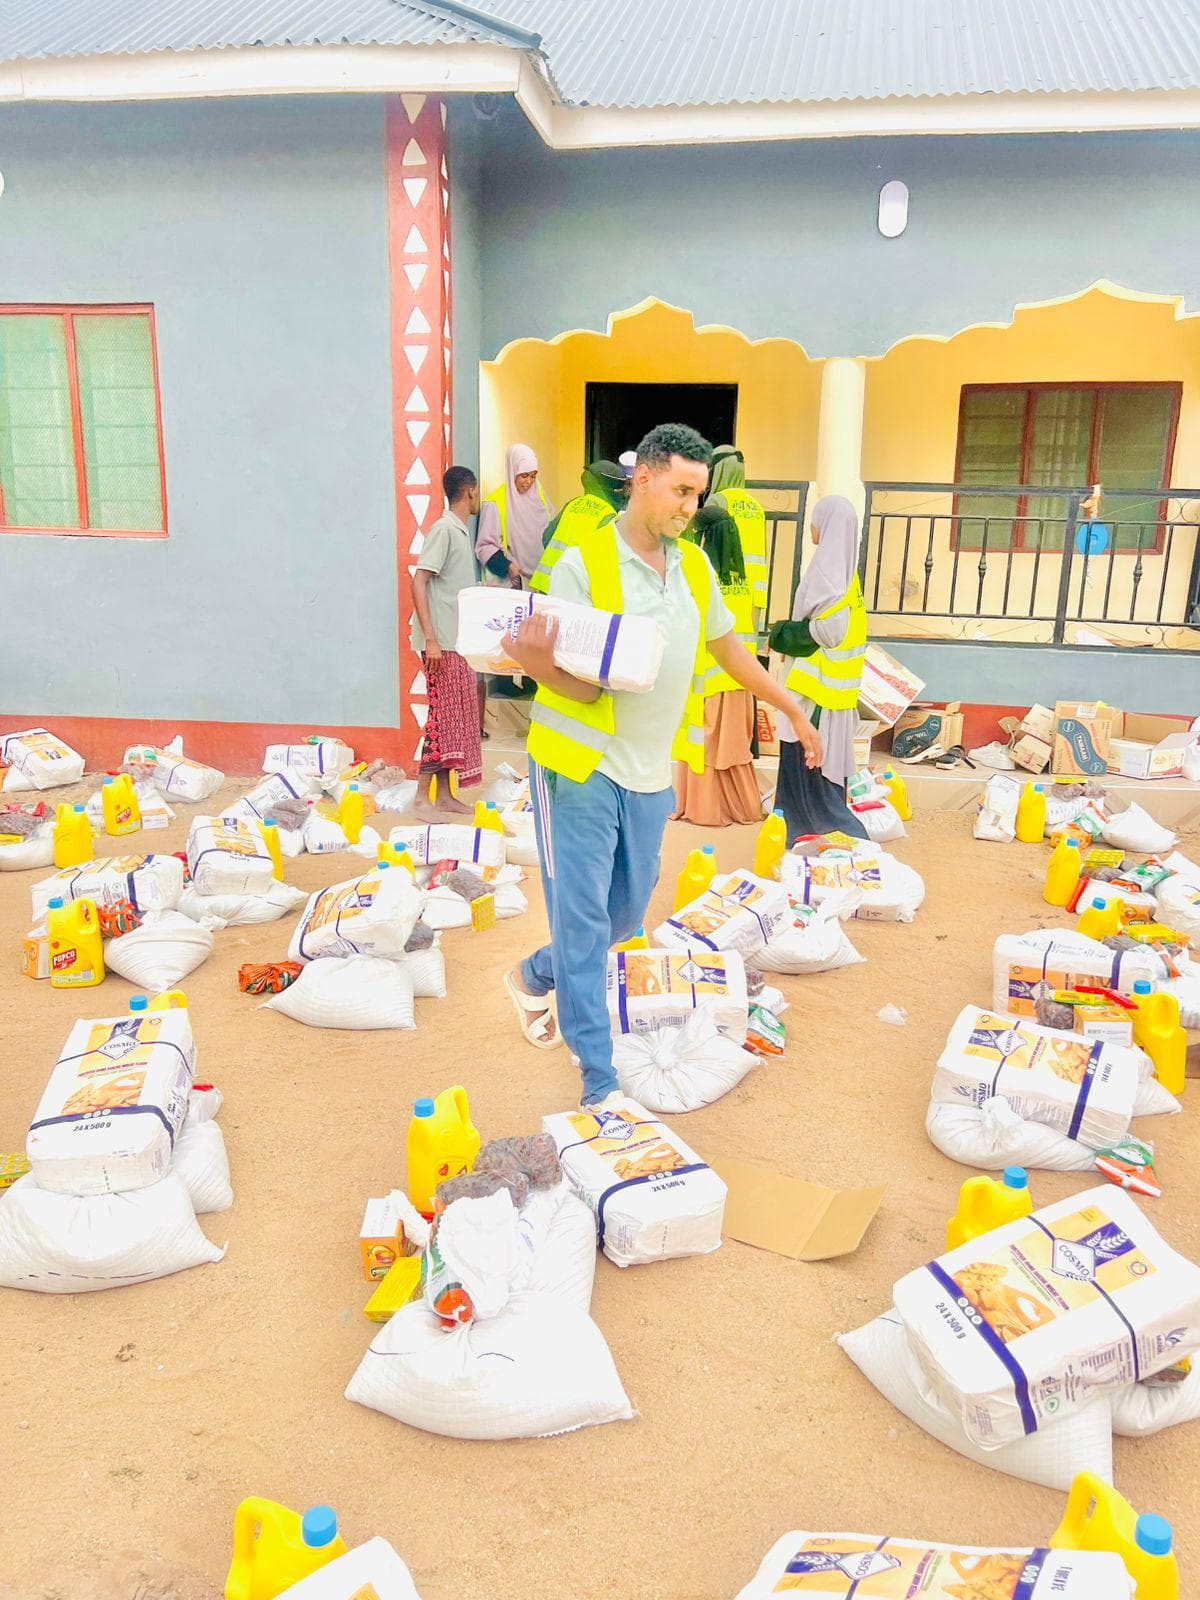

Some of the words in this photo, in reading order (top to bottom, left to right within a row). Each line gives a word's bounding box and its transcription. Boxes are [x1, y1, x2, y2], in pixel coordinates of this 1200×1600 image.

[603, 1122, 632, 1136] COSMO
[1059, 1244, 1090, 1276] COSMO
[935, 1302, 948, 1314] 24
[946, 1317, 963, 1333] 500
